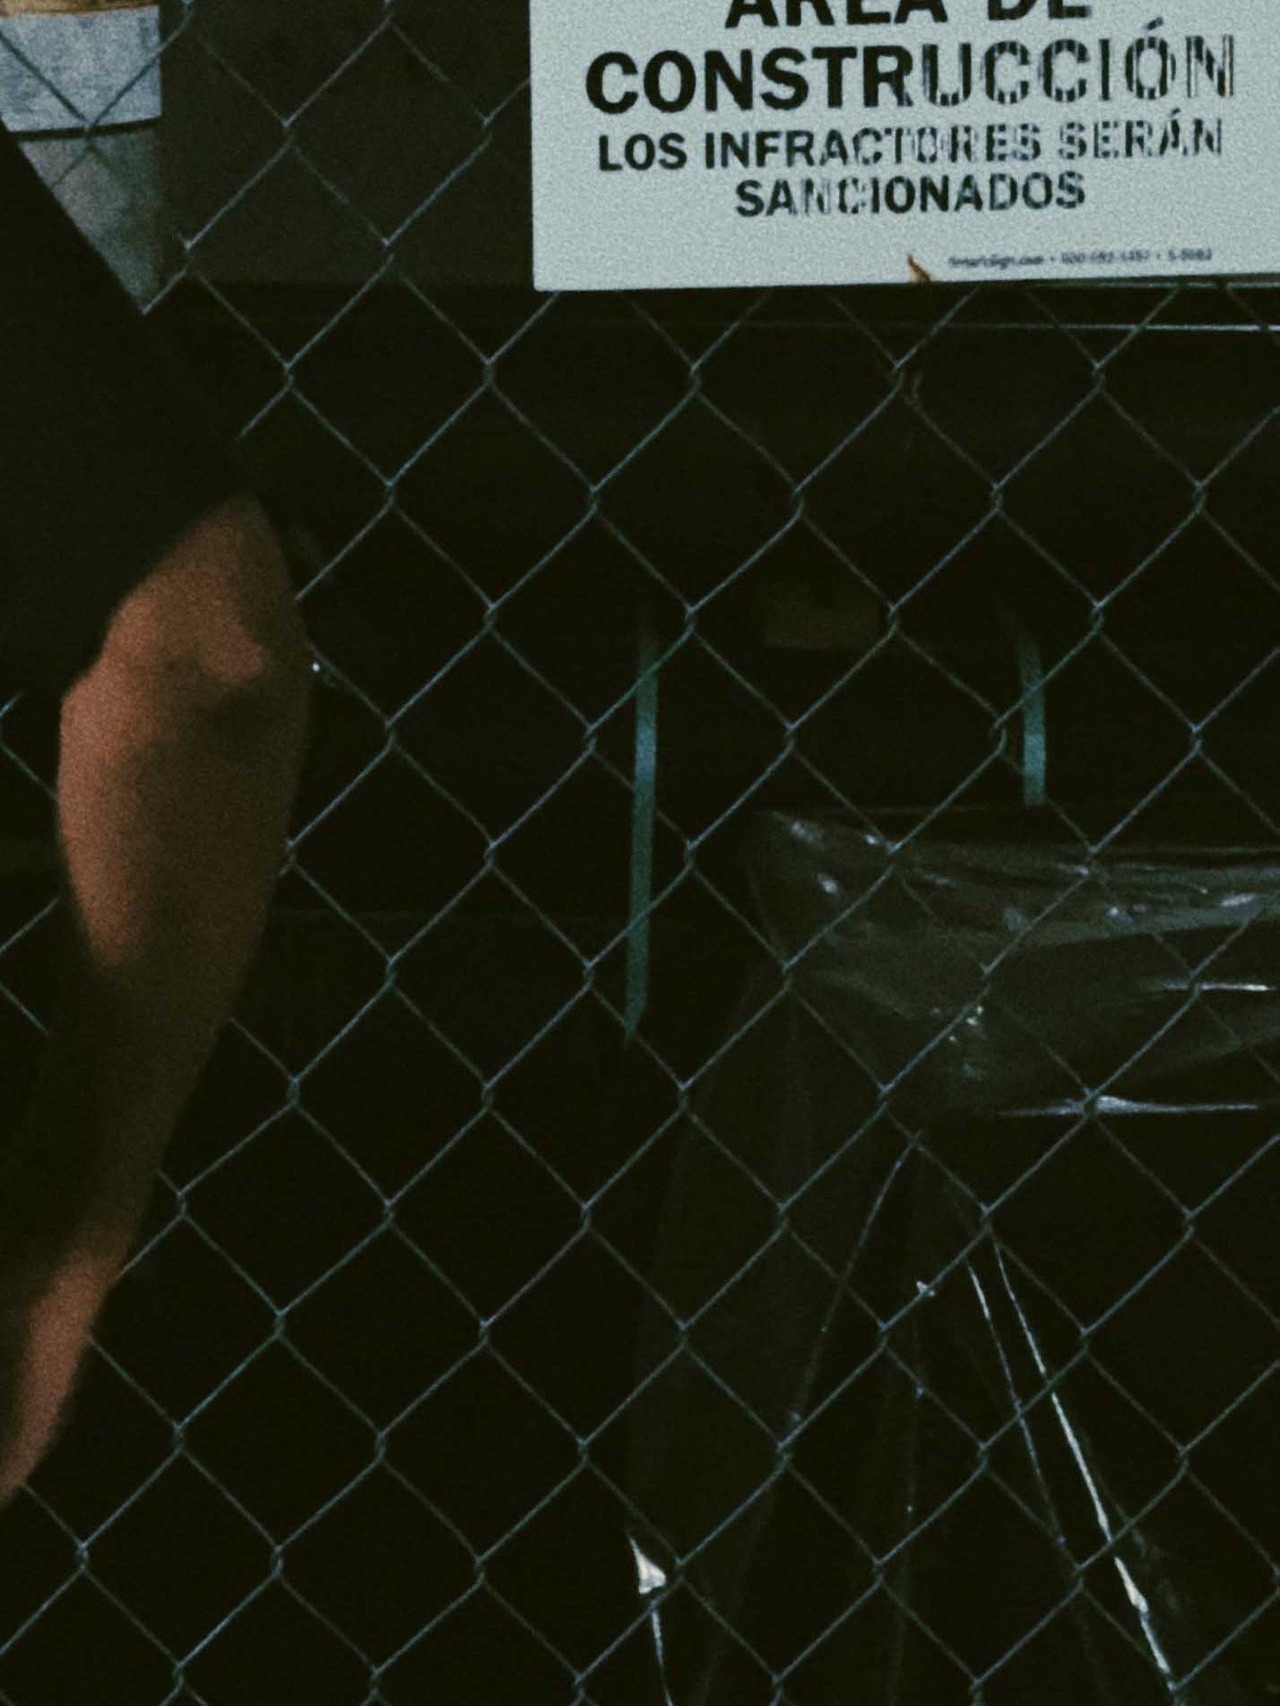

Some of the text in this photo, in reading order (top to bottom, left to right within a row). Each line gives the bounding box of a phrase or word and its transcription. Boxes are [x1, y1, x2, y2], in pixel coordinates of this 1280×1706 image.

[585, 16, 1234, 115] CONSTRUCCIÓN
[599, 108, 1221, 172] LOS INFRACTORES SERÁN
[736, 170, 1085, 217] SANCIONADOS
